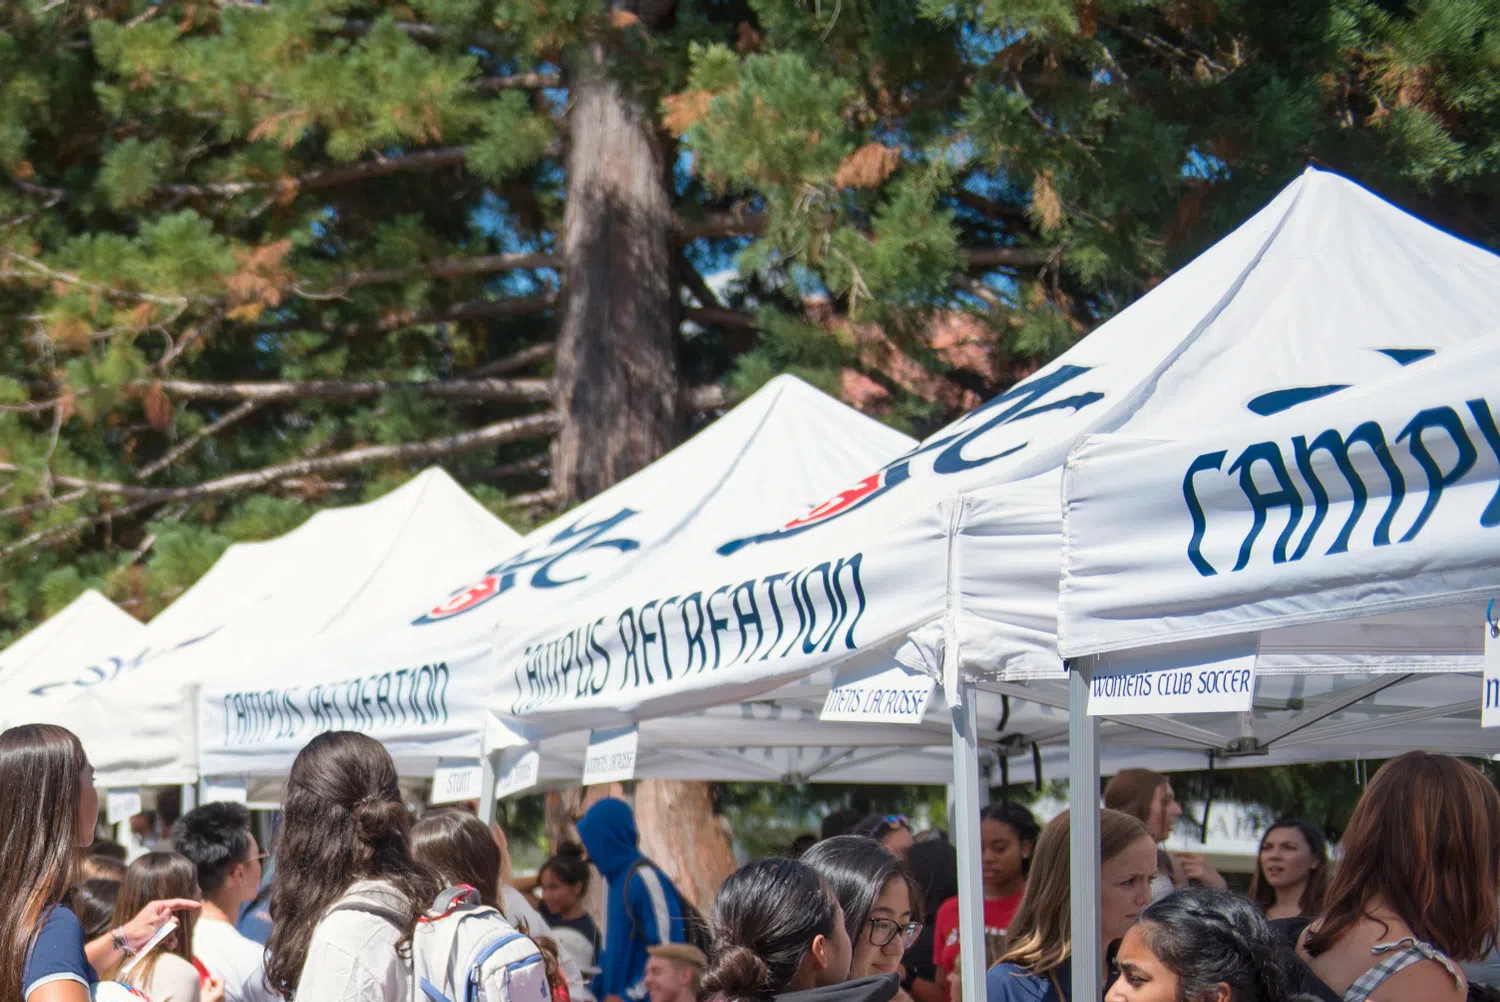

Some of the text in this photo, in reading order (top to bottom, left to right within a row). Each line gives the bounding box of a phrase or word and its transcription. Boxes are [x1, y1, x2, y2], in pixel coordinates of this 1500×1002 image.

[511, 616, 611, 715] CAMPUS
[617, 552, 866, 691] RECREATION
[224, 661, 449, 746] CAMPUS RECREATION
[862, 689, 928, 714] LACROSSE
[1093, 669, 1251, 698] WOMEN'S CLUB SOCCER
